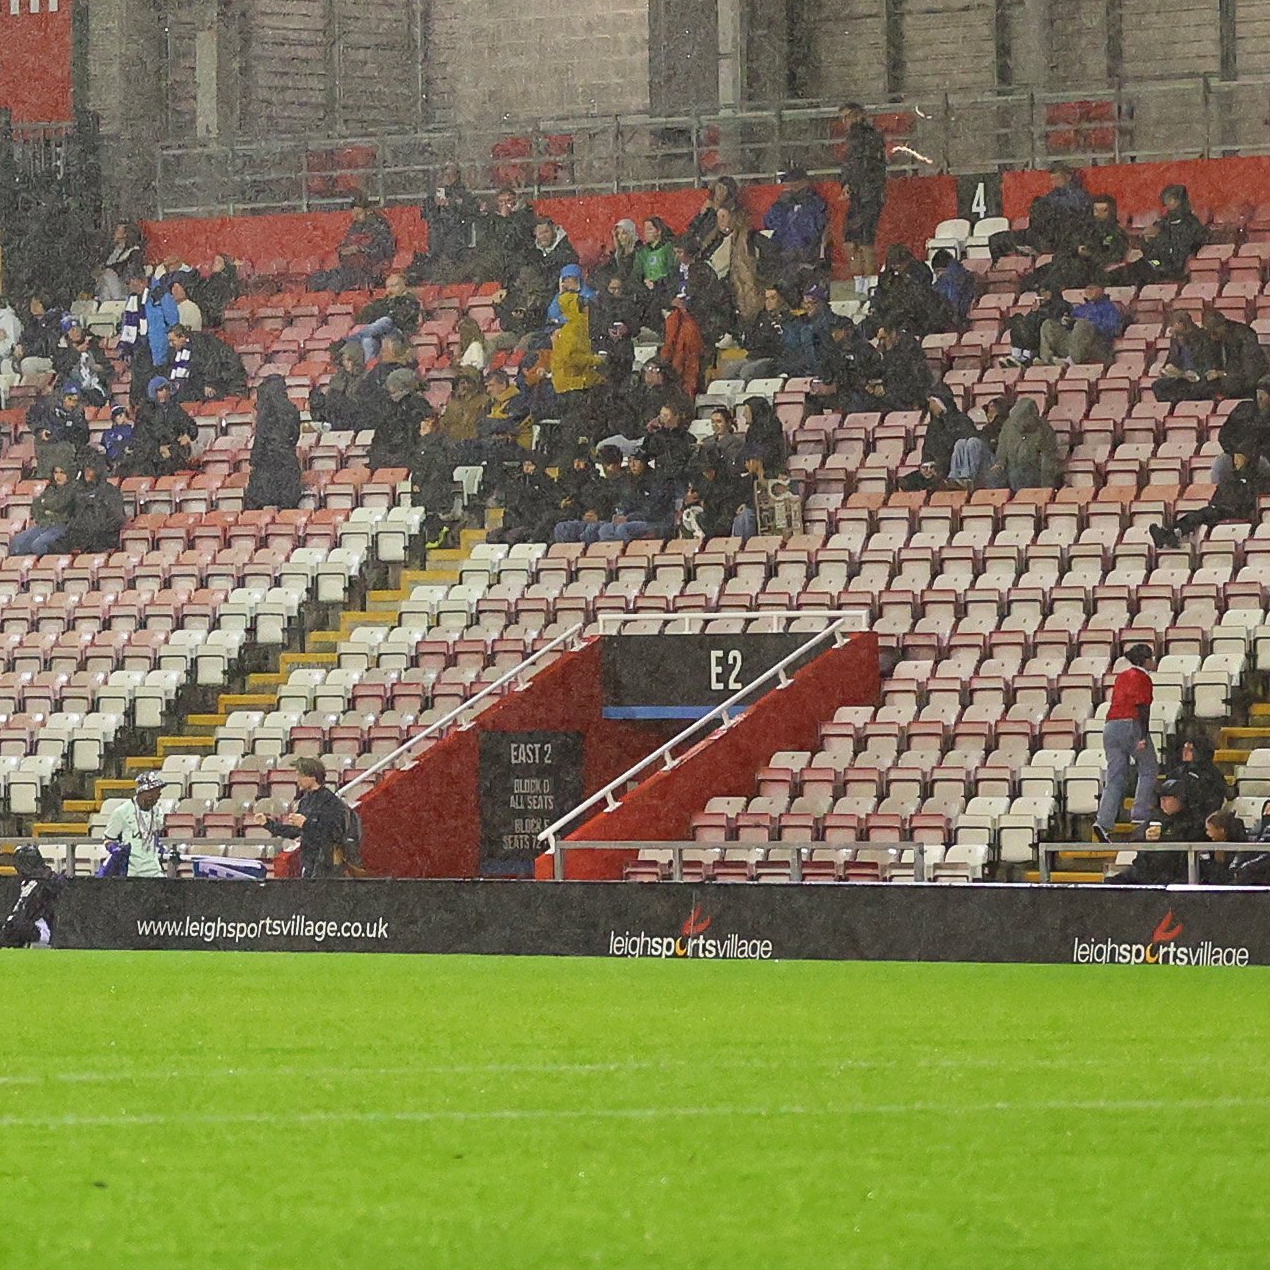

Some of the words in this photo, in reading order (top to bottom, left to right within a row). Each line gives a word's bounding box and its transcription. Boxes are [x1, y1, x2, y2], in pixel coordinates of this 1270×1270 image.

[971, 182, 987, 218] 4
[710, 649, 743, 691] E2
[510, 743, 541, 765] EAST
[544, 743, 552, 764] 2
[509, 795, 524, 810] ALL
[526, 795, 554, 810] SEATS
[136, 914, 389, 942] www.leighsportsvillage.co.uk
